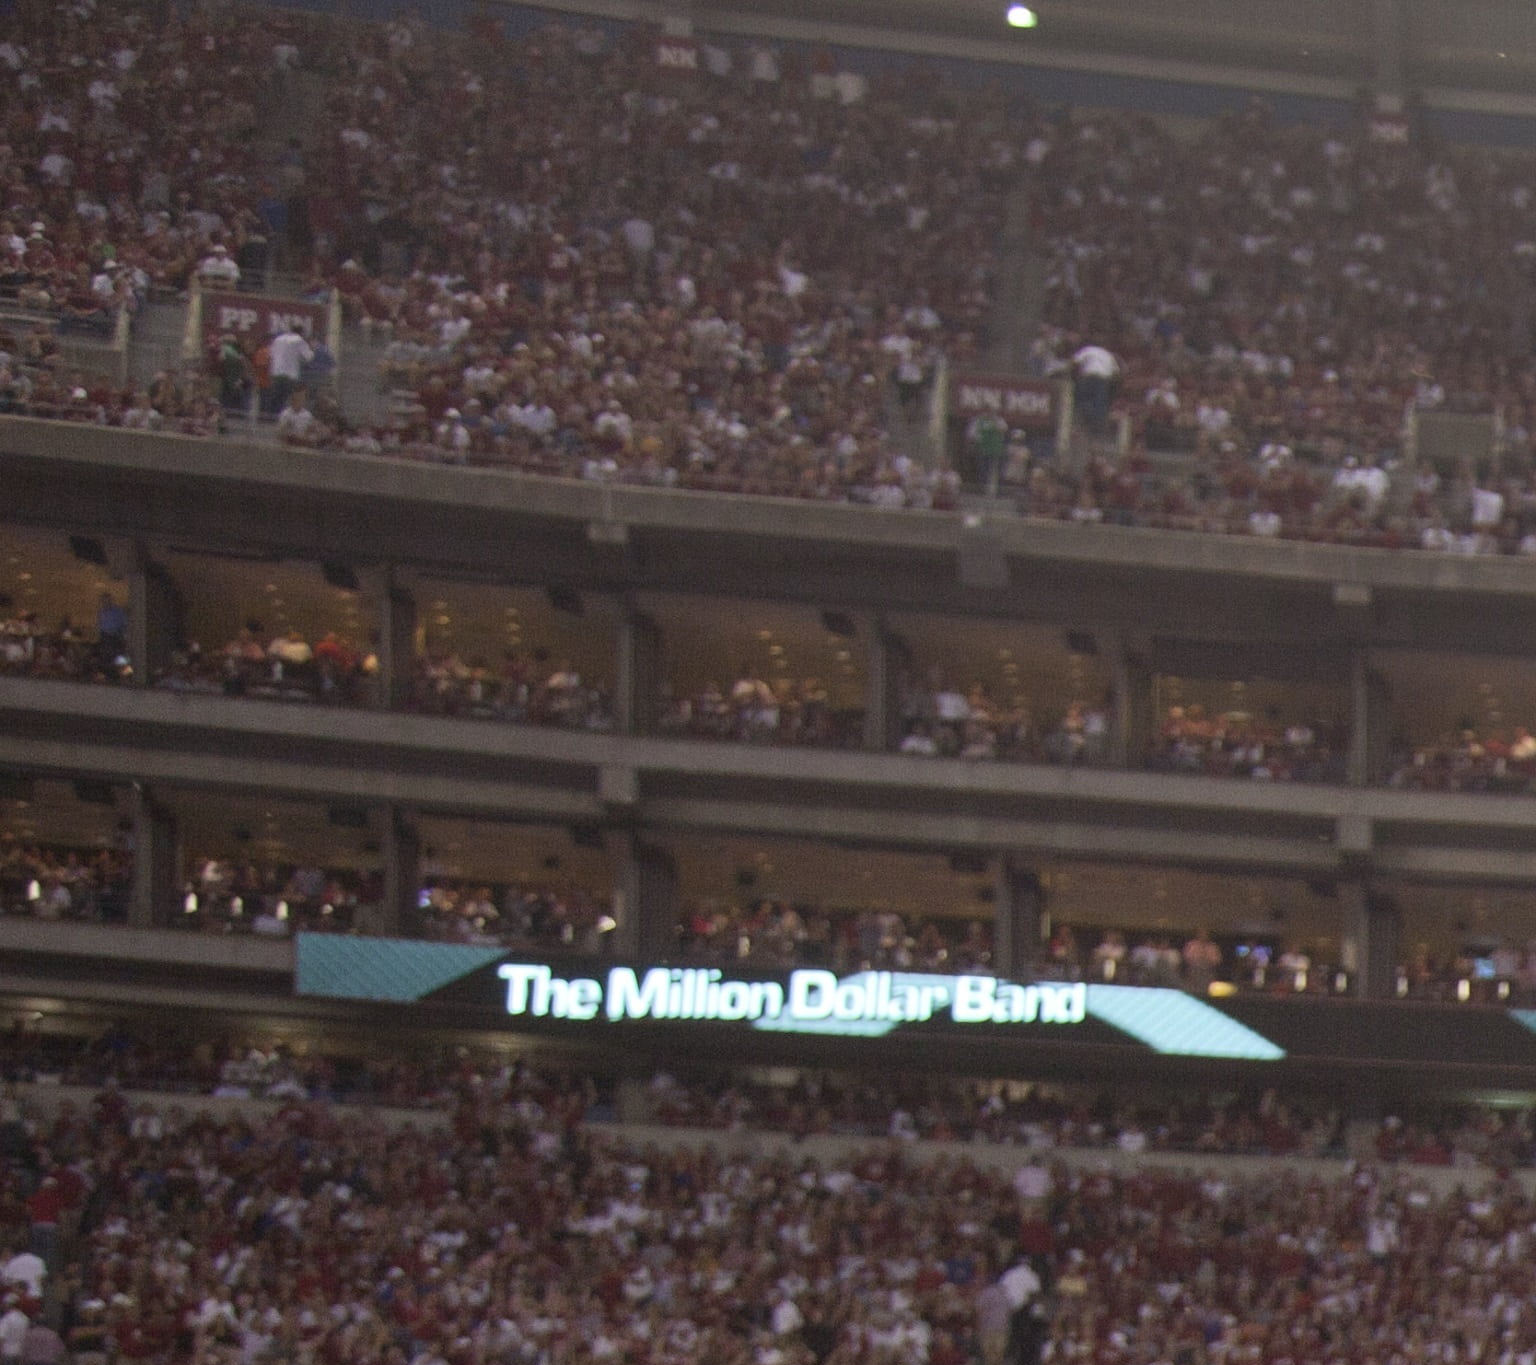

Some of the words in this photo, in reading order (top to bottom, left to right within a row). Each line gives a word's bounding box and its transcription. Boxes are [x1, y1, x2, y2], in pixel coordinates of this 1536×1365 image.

[219, 306, 258, 332] PP
[498, 963, 602, 1019] The
[606, 966, 784, 1021] Million
[788, 969, 948, 1022] Dollar
[951, 976, 1087, 1024] Band
